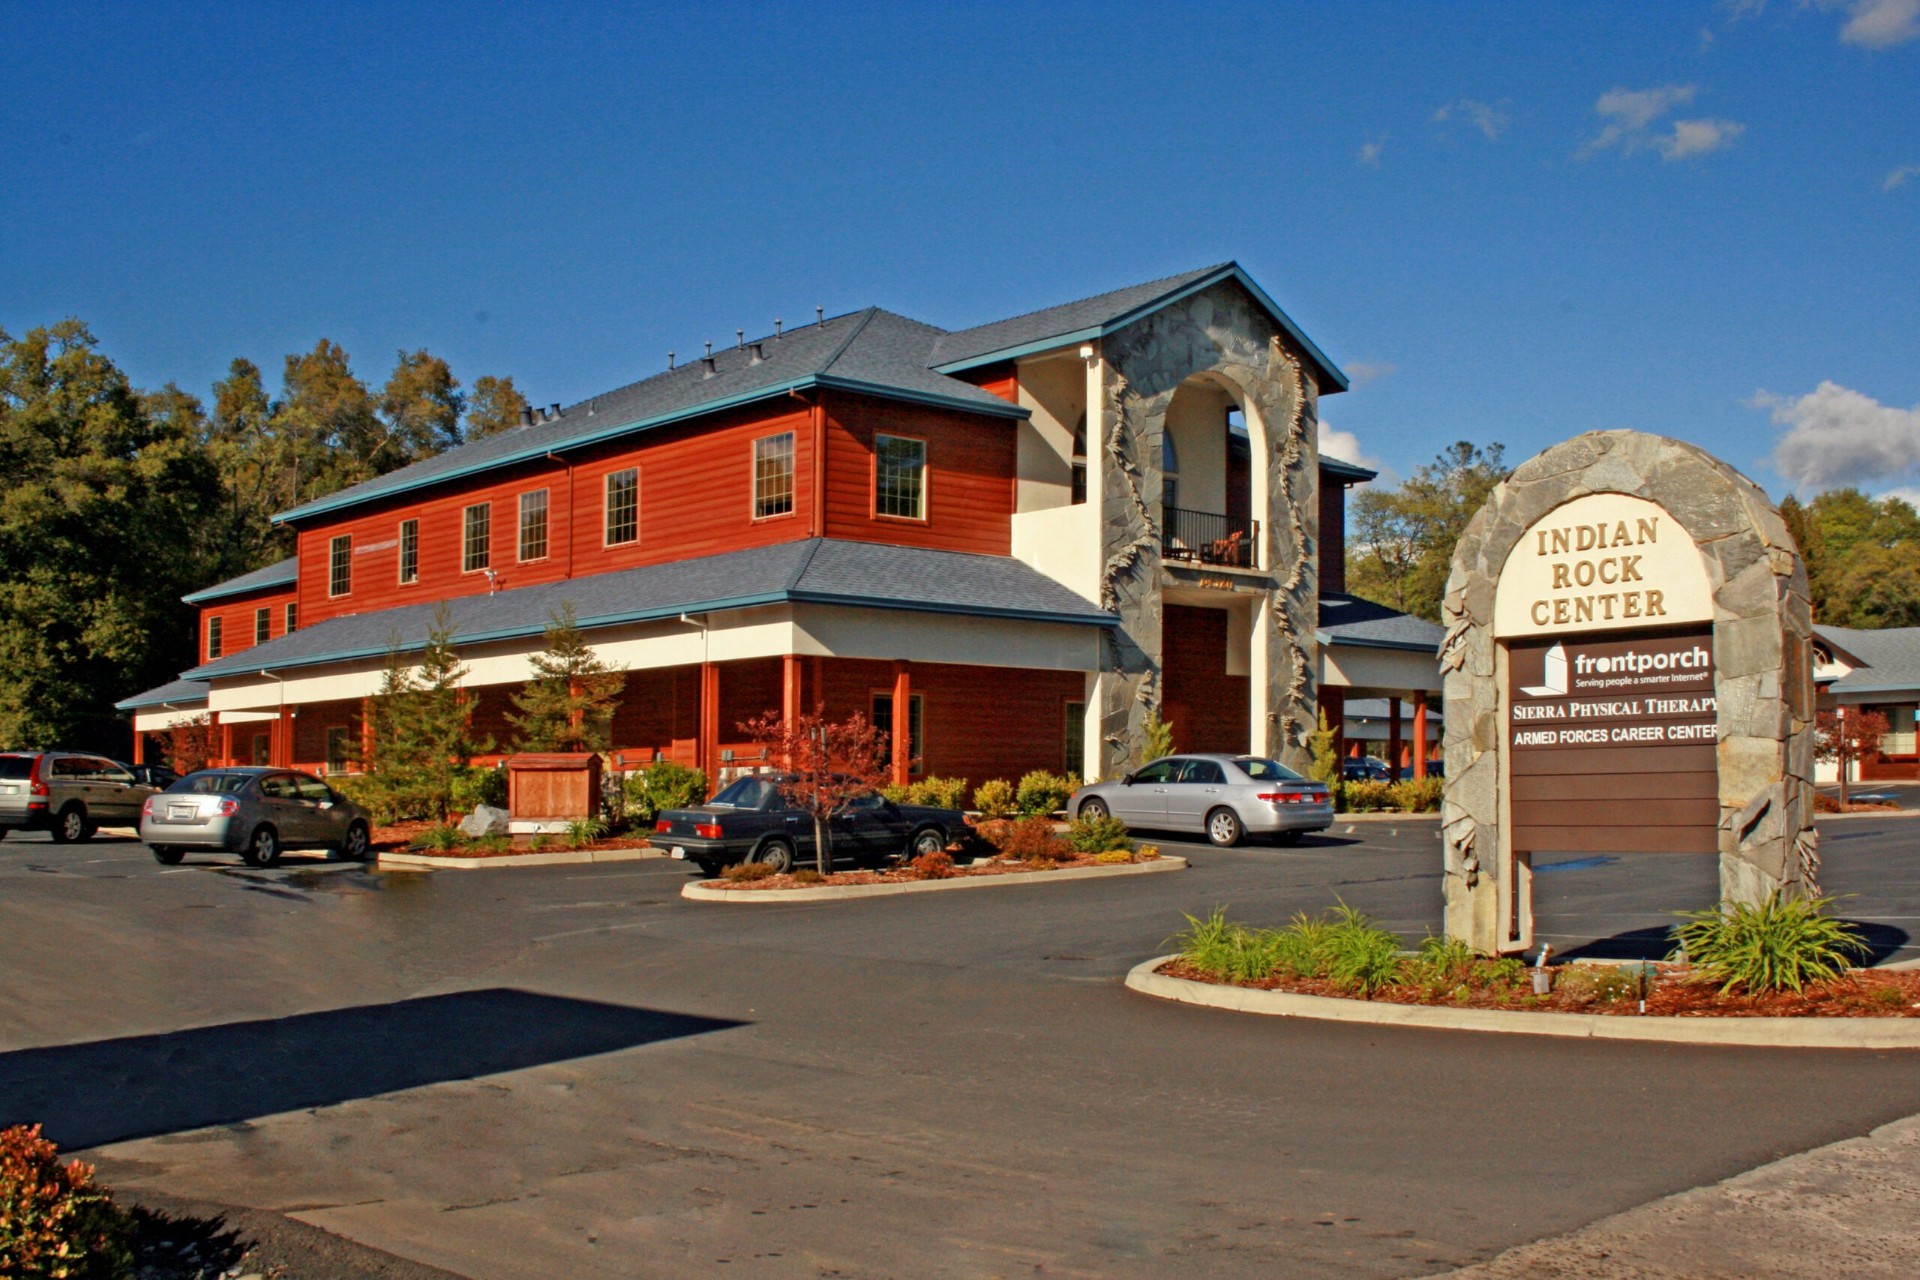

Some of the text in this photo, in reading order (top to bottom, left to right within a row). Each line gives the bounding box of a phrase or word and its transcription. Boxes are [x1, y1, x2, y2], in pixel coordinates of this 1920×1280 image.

[1537, 516, 1659, 556] INDIAN
[1552, 554, 1643, 589] ROCK
[1530, 589, 1667, 626] CENTER
[1575, 646, 1709, 674] frontporch
[1575, 678, 1604, 689] Serving
[1605, 675, 1632, 687] people
[1640, 674, 1670, 684] smarter
[1513, 704, 1566, 720] SIERRA
[1569, 701, 1641, 718] PHYSICAL
[1514, 731, 1557, 745] ARMED
[1560, 729, 1608, 743] FORCES
[1611, 726, 1664, 742] CAREER
